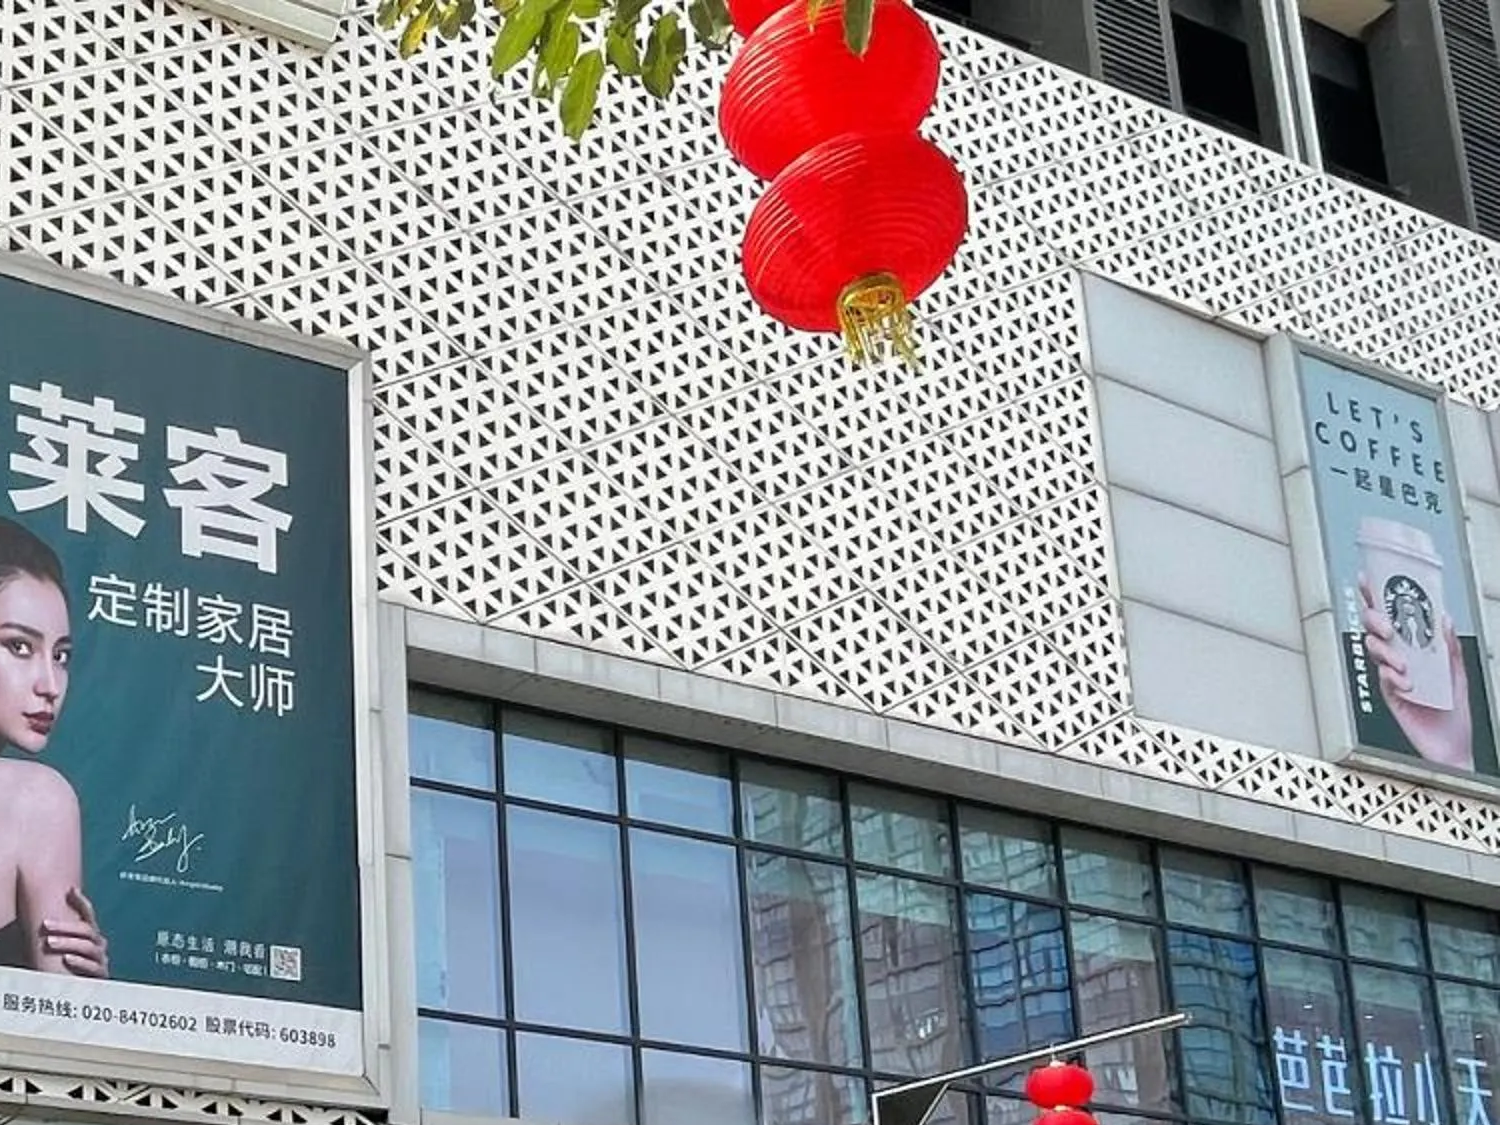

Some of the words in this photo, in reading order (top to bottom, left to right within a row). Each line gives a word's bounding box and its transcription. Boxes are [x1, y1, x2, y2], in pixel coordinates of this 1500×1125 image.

[1326, 391, 1423, 444] LET'S
[1315, 421, 1446, 483] COFFEE
[88, 573, 294, 659] 定制家居
[196, 654, 296, 717] 大师
